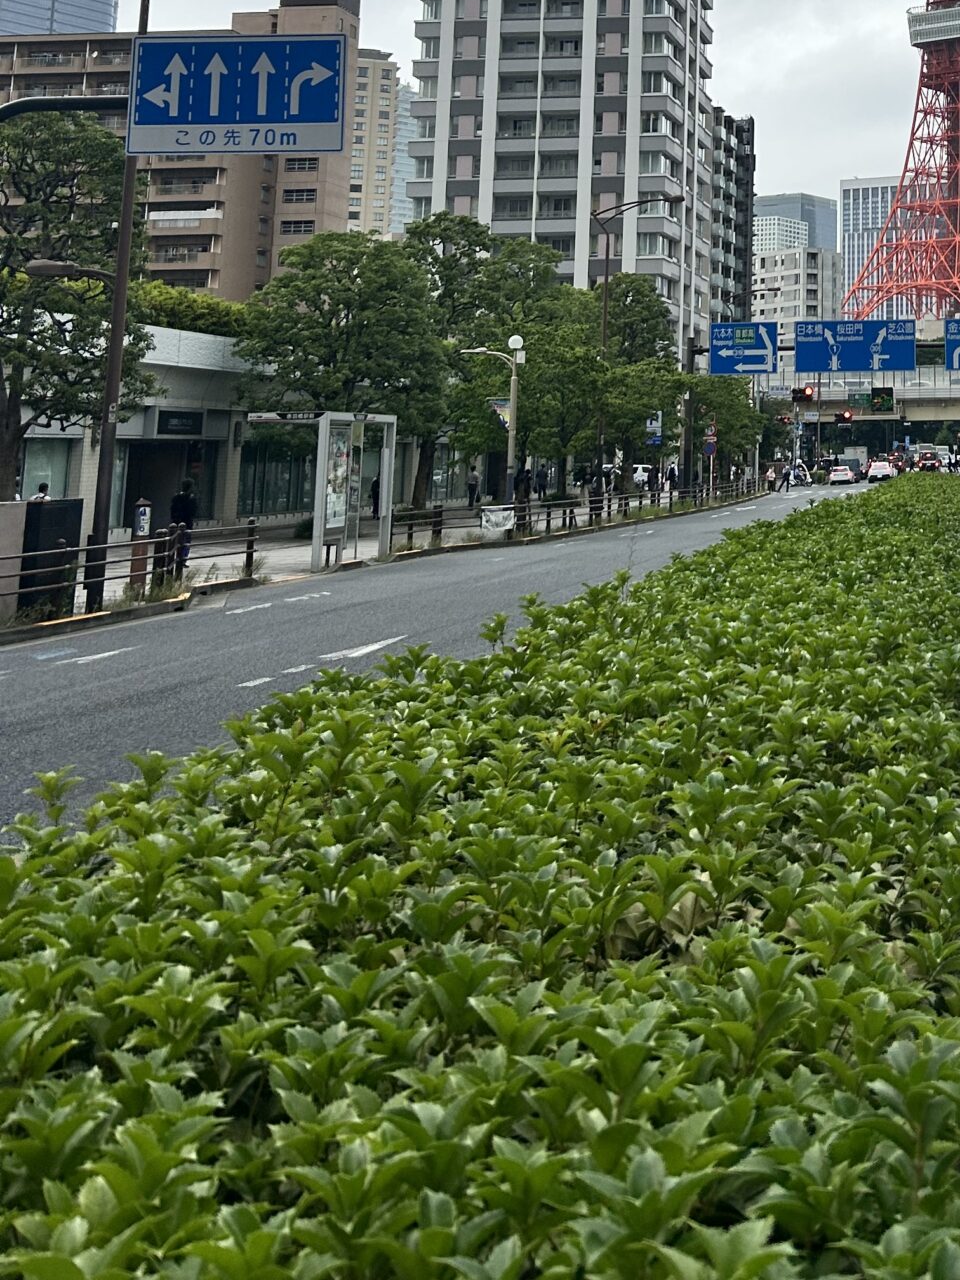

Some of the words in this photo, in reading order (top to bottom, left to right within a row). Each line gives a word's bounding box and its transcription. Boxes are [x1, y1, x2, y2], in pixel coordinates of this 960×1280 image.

[176, 130, 241, 146] この先
[249, 128, 297, 146] 70m
[712, 328, 733, 338] 六本木
[797, 324, 823, 335] 日本橋
[837, 323, 863, 334] 桜田門
[887, 322, 914, 333] 芝公園
